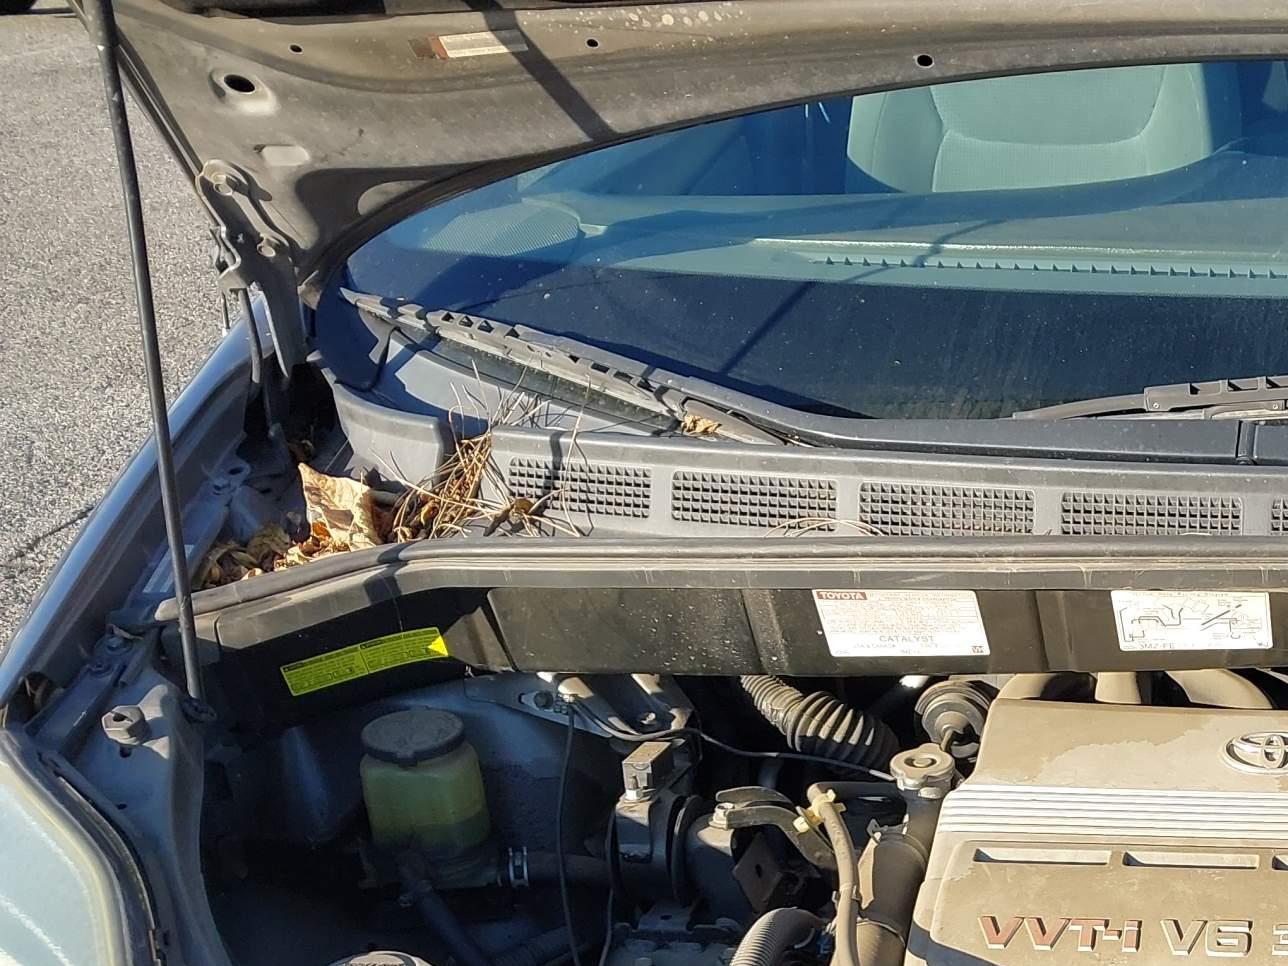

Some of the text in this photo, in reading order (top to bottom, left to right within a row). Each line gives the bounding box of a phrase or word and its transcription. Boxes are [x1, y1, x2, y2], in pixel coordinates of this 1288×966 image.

[819, 591, 865, 600] TOYOTA
[879, 635, 934, 643] CATALYST
[1160, 919, 1254, 957] V6
